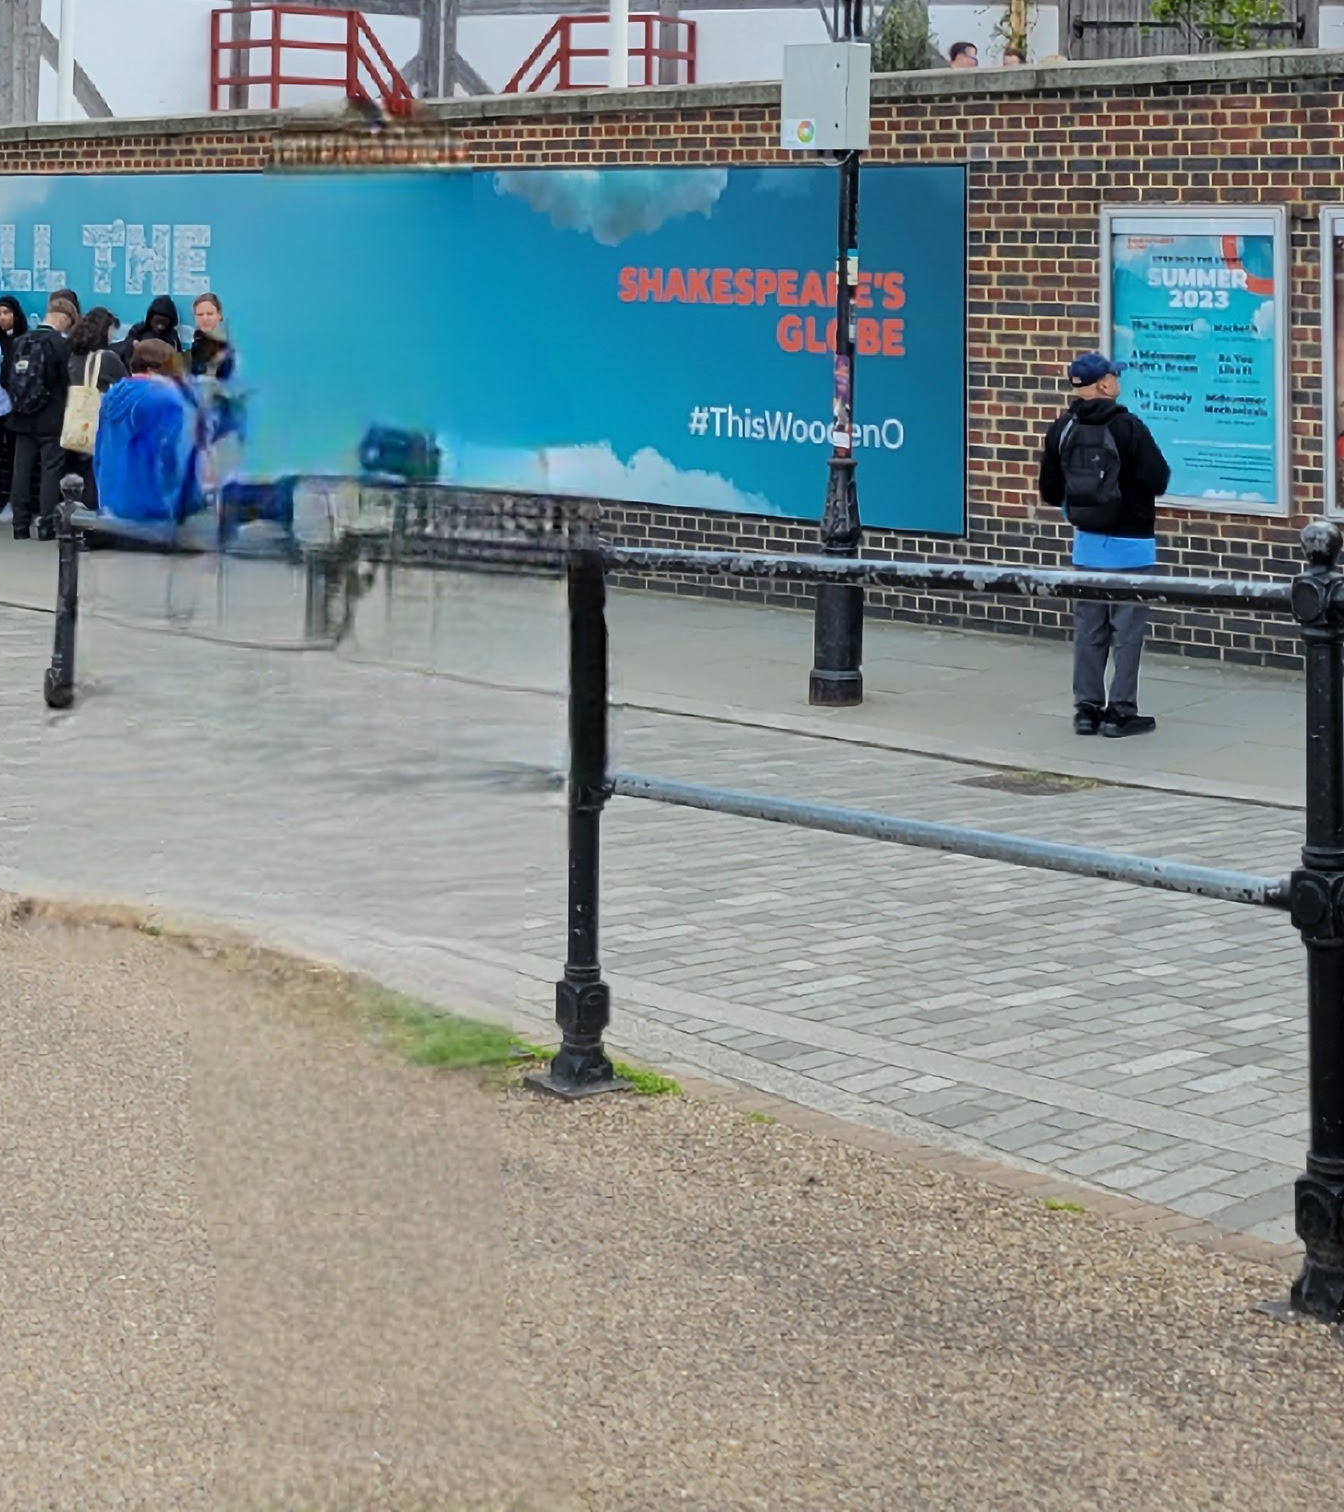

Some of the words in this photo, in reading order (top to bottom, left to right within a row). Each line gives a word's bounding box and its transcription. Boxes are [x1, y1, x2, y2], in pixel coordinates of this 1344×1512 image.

[82, 219, 212, 295] THE
[618, 267, 906, 310] SHAKESPEAE'S
[1148, 268, 1248, 290] SUMMER
[1169, 289, 1230, 309] 2023
